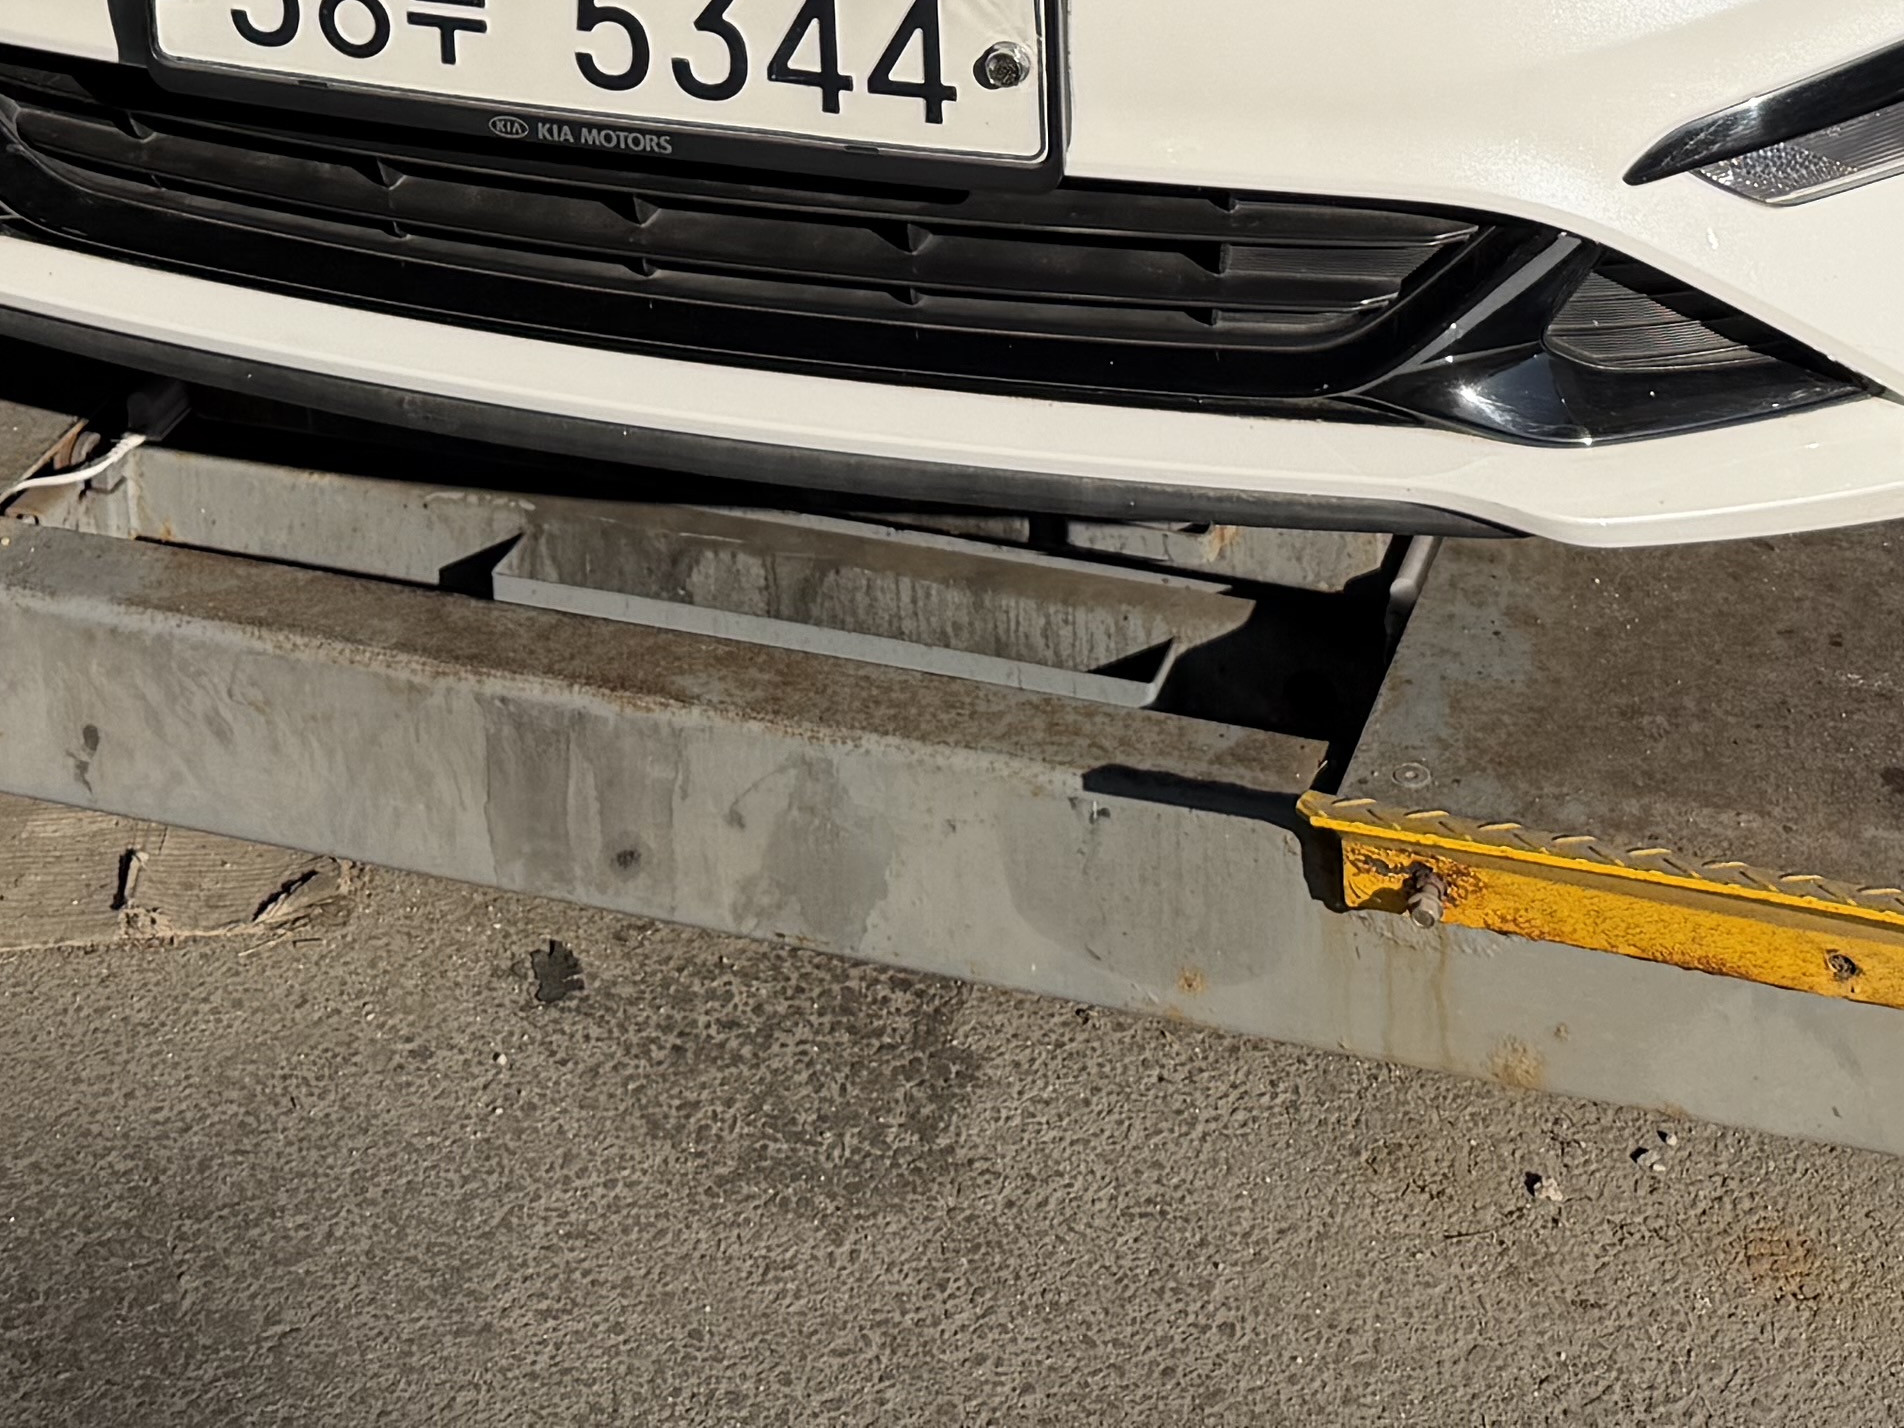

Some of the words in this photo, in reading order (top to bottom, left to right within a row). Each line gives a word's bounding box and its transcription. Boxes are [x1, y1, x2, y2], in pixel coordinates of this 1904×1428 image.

[496, 120, 524, 135] KIA
[537, 122, 574, 143] KIA
[580, 127, 673, 154] MOTORS
